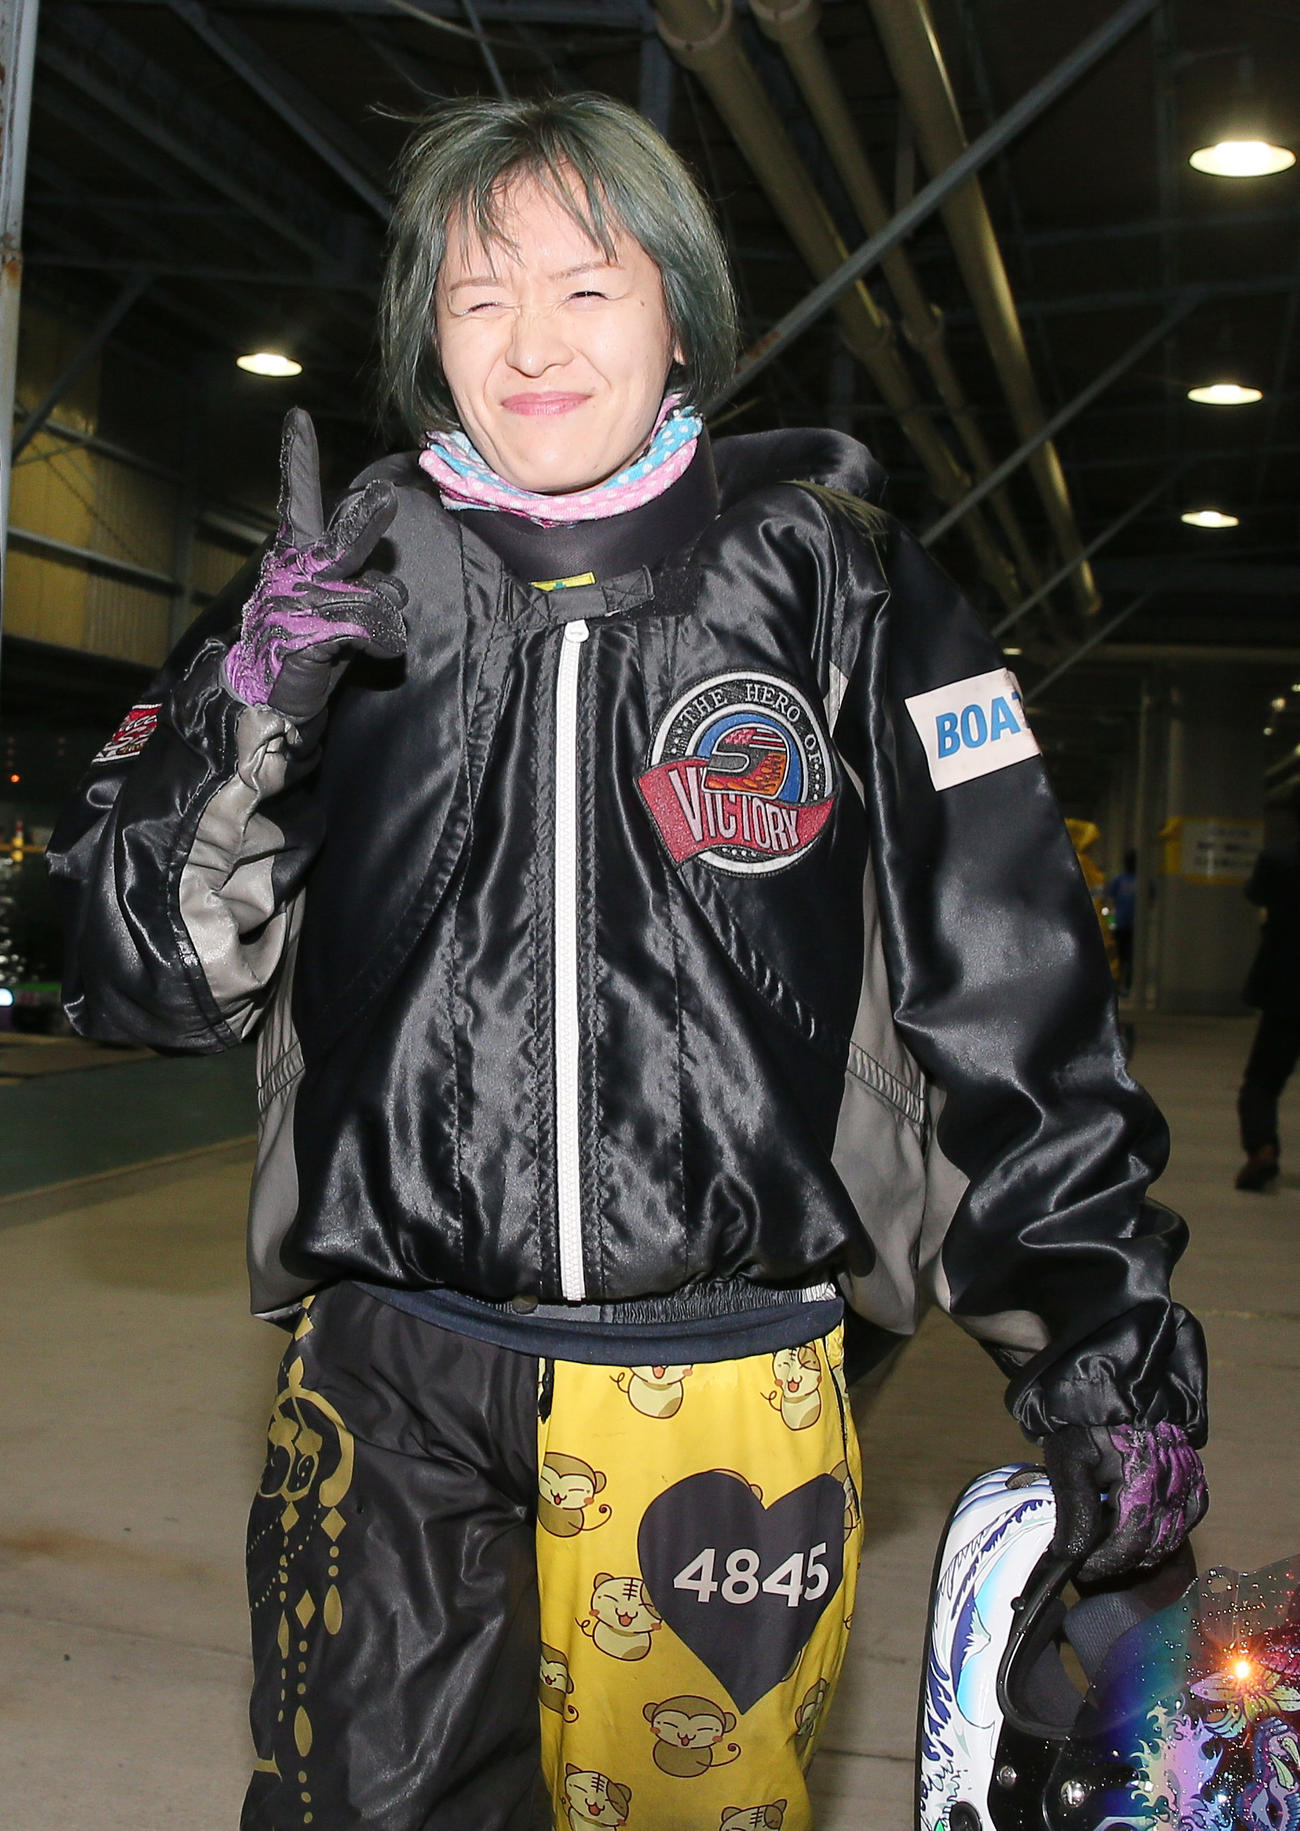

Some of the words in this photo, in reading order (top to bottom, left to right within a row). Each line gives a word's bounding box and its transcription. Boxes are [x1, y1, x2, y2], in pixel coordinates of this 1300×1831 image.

[680, 688, 727, 726] THE
[744, 683, 801, 722] HERO
[804, 733, 822, 765] OF
[668, 766, 799, 851] VICTORY
[673, 1542, 829, 1608] 4845
